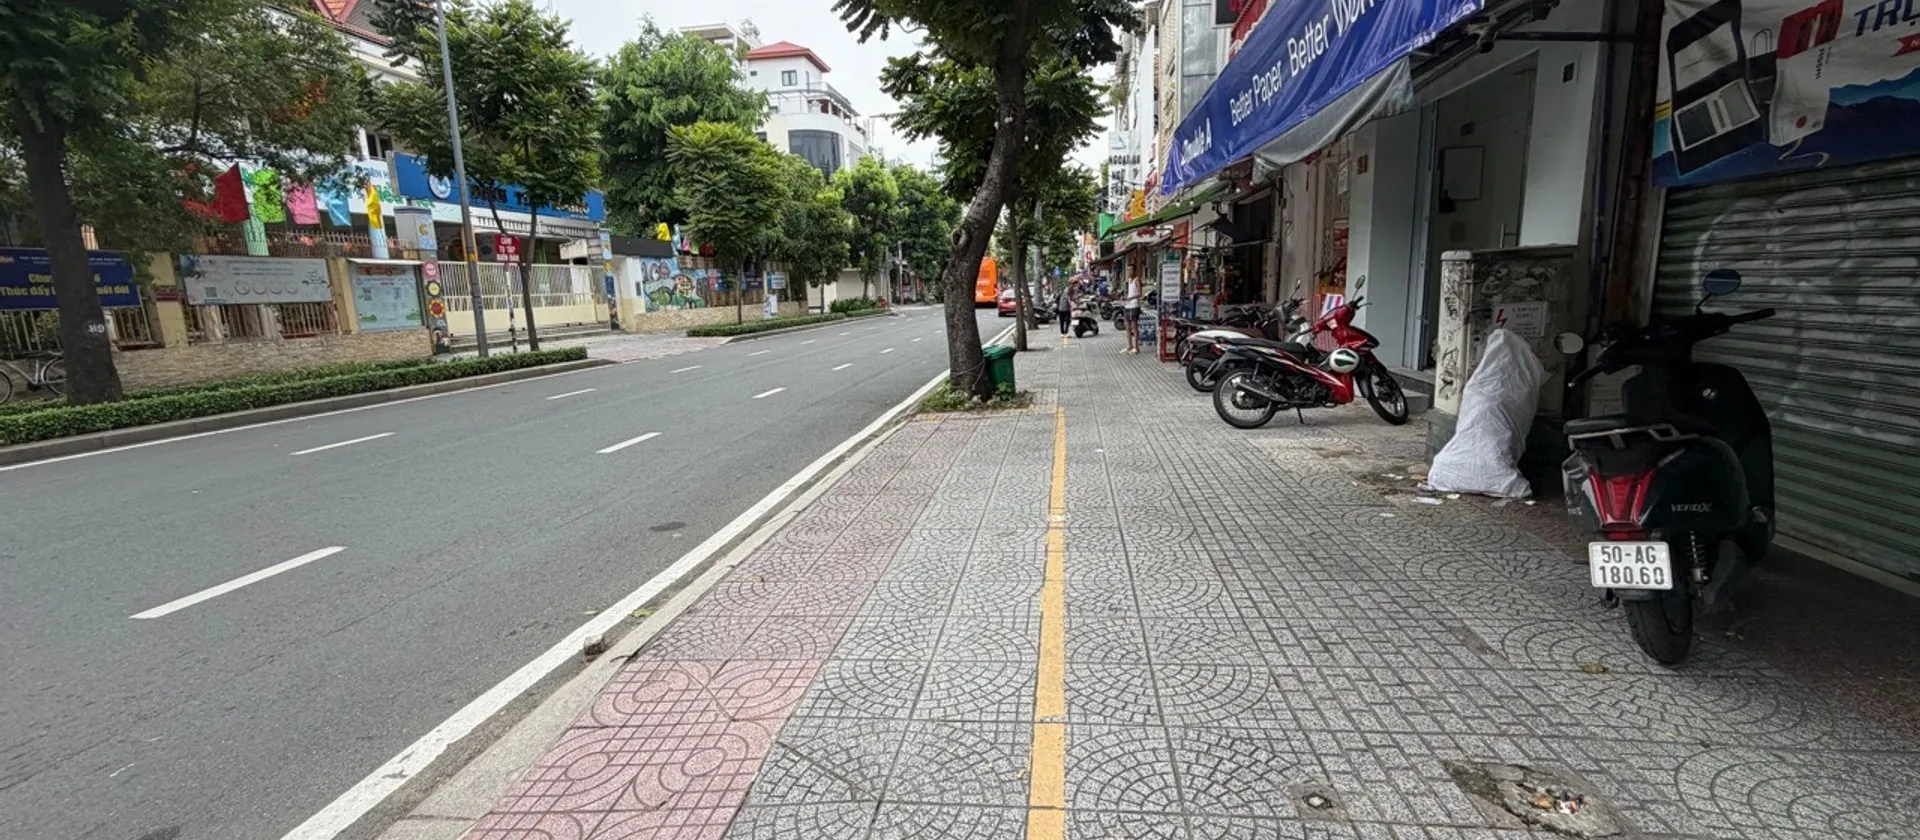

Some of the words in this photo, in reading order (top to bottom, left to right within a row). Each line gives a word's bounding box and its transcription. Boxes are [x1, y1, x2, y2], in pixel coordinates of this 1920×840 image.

[1229, 88, 1253, 127] Better
[1252, 60, 1283, 108] Paper
[1287, 13, 1329, 77] Better
[1601, 545, 1657, 565] 50-AG
[1599, 566, 1665, 586] 180.60
